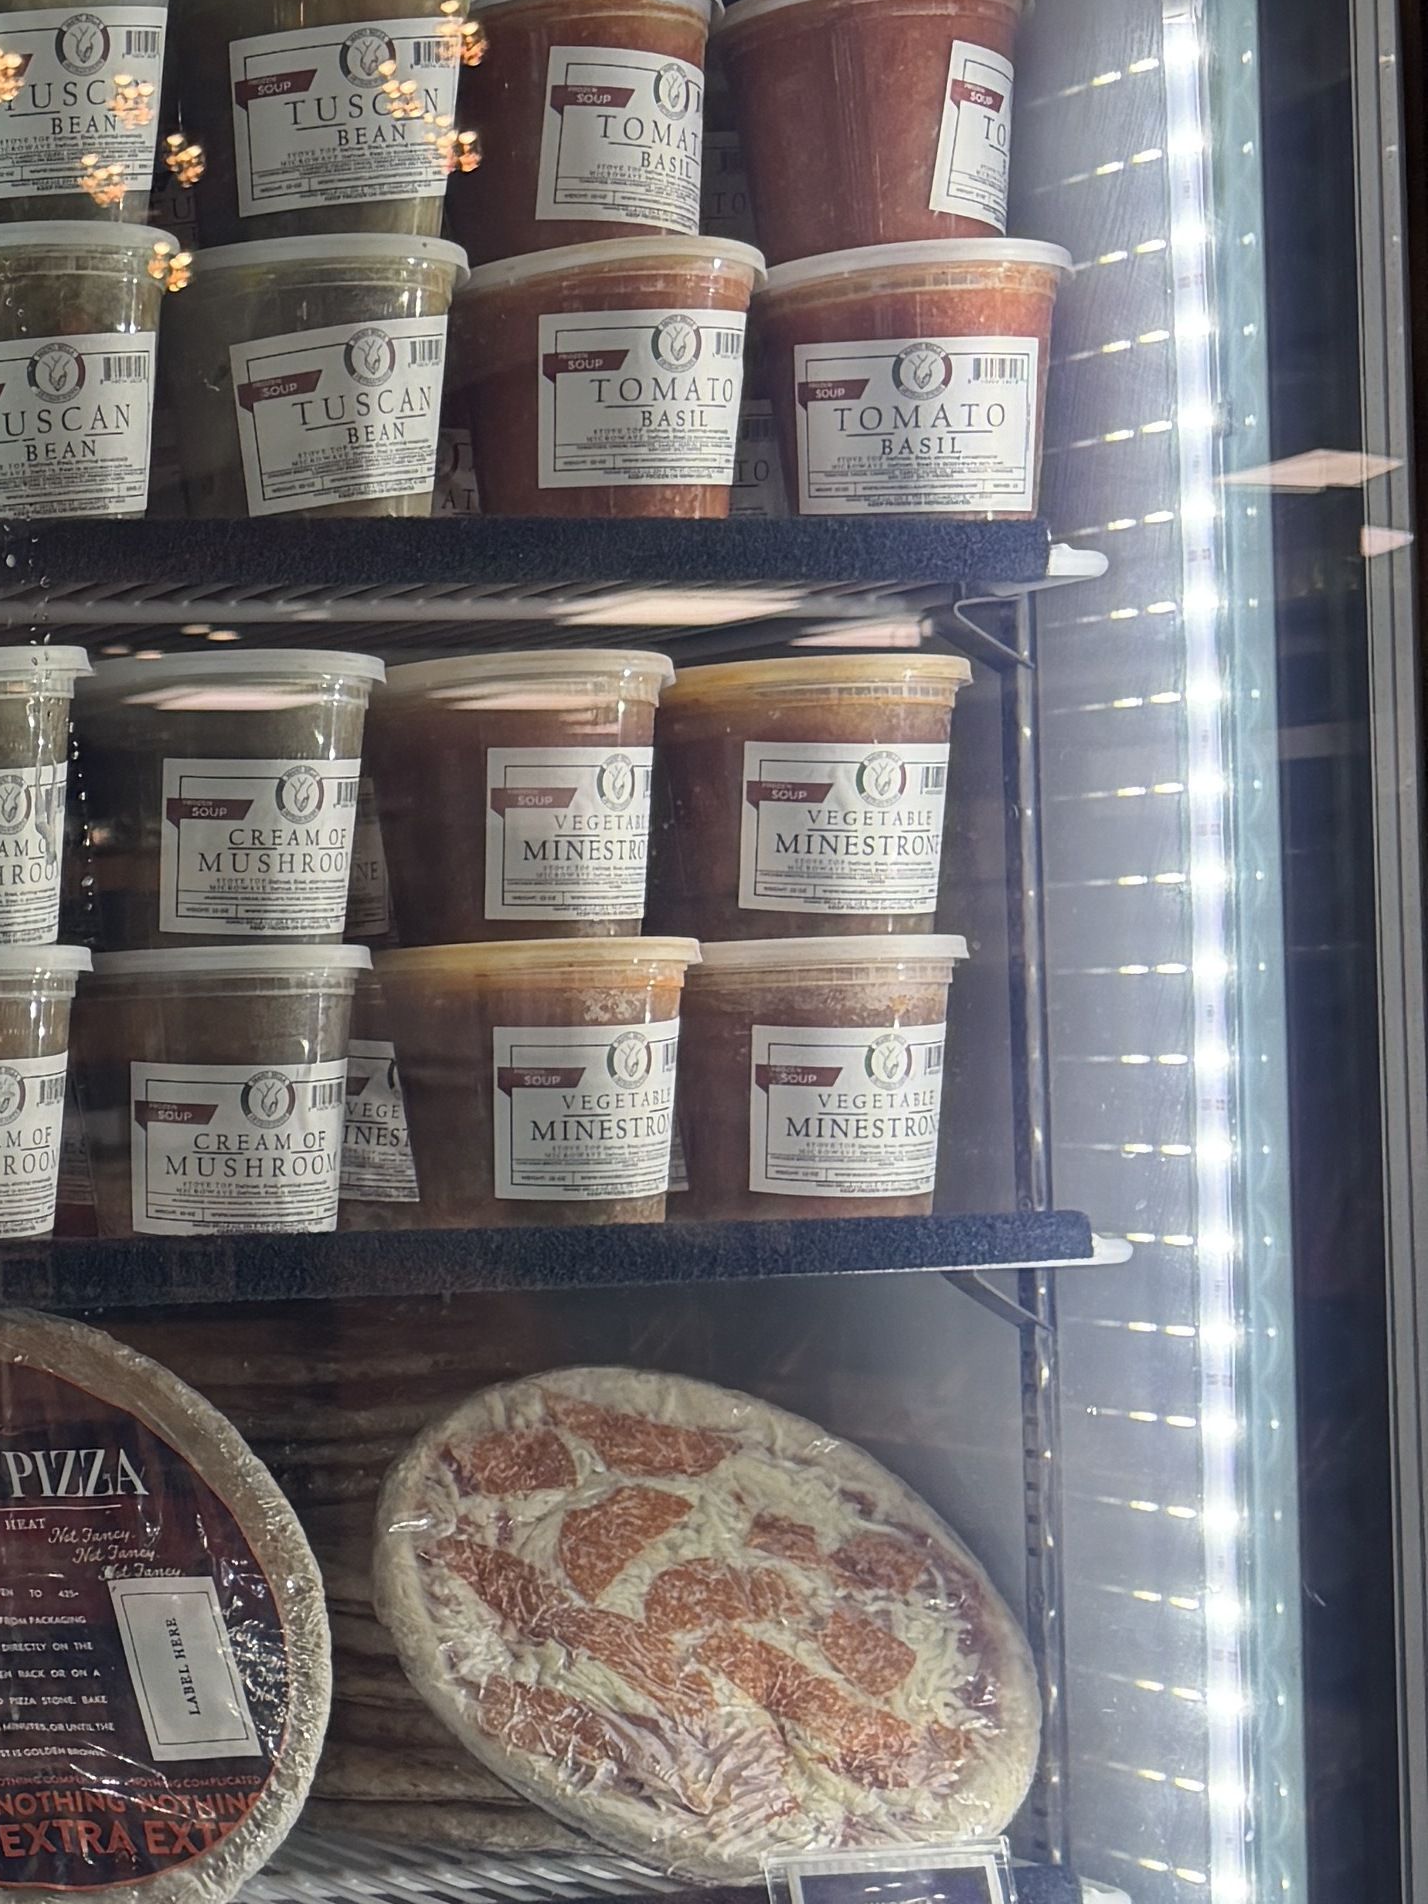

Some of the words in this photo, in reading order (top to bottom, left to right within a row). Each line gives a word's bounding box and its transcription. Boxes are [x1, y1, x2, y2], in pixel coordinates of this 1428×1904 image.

[257, 80, 291, 95] SOUP
[576, 92, 612, 105] SOUP
[970, 92, 993, 106] SOUP
[51, 114, 118, 135] BEAN
[337, 123, 407, 147] BEAN
[640, 150, 693, 180] BASIL
[567, 357, 604, 370] SOUP
[262, 382, 298, 397] SOUP
[590, 377, 734, 403] TOMATO
[815, 386, 845, 398] SOUP
[292, 386, 433, 426] TUSCAN
[640, 410, 708, 429] BASIL
[833, 403, 1006, 432] TOMATO
[346, 421, 405, 444] BEAN
[25, 439, 96, 462] BEAN
[880, 436, 963, 456] BASIL
[518, 796, 553, 806] SOUP
[771, 790, 807, 801] SOUP
[192, 806, 227, 818] SOUP
[807, 810, 933, 828] VEGETABLE
[228, 828, 311, 848] CREAM
[328, 828, 347, 848] OF
[524, 1075, 560, 1086] SOUP
[780, 1073, 817, 1085] SOUP
[562, 1089, 671, 1111] VEGETABLE
[817, 1093, 935, 1111] VEGETABLE
[158, 1111, 193, 1122] SOUP
[32, 1127, 53, 1148] OF
[193, 1132, 280, 1151] CREAM
[303, 1131, 326, 1151] OF
[1, 1448, 150, 1498] PIZZA
[5, 1517, 46, 1530] HEAT
[48, 1528, 77, 1543] Not
[82, 1528, 136, 1544] Fancy.
[72, 1548, 101, 1563] Not
[107, 1547, 160, 1563] Fancy.
[53, 1643, 68, 1651] ON
[74, 1641, 93, 1650] THE
[166, 1617, 186, 1659] HERE
[179, 1665, 201, 1715] LABEL
